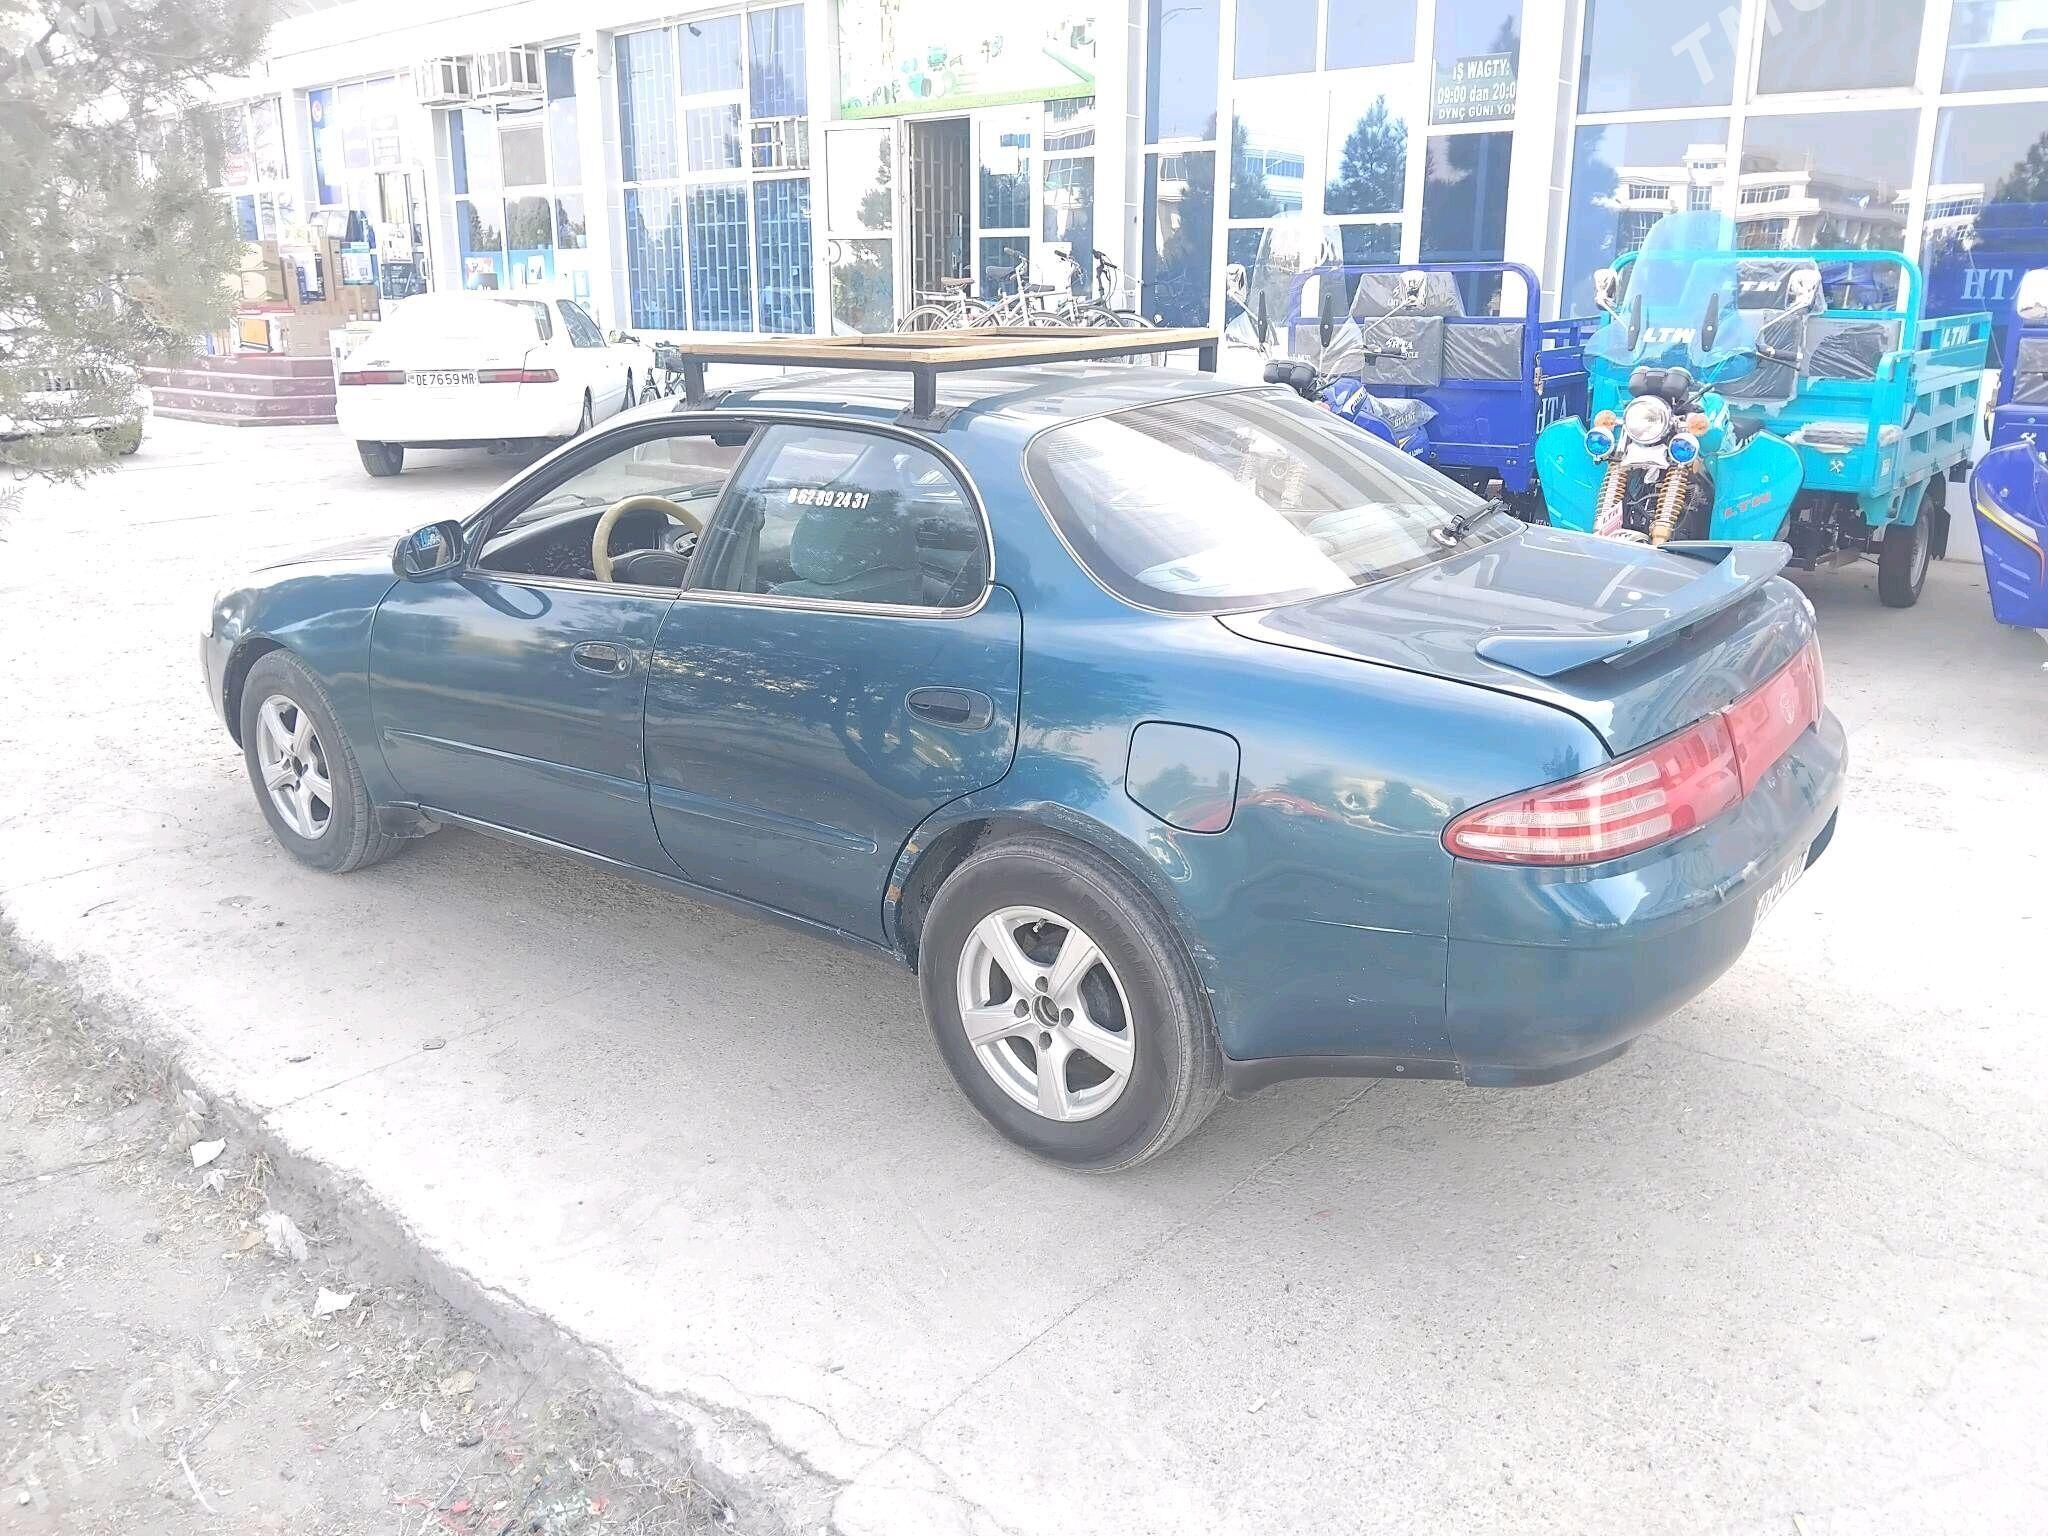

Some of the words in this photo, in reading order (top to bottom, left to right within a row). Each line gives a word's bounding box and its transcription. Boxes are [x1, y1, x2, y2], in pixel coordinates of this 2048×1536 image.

[1438, 85, 1467, 105] 09:00
[1470, 84, 1489, 101] dan
[1642, 327, 1697, 344] LTW
[1942, 325, 1970, 348] LTW
